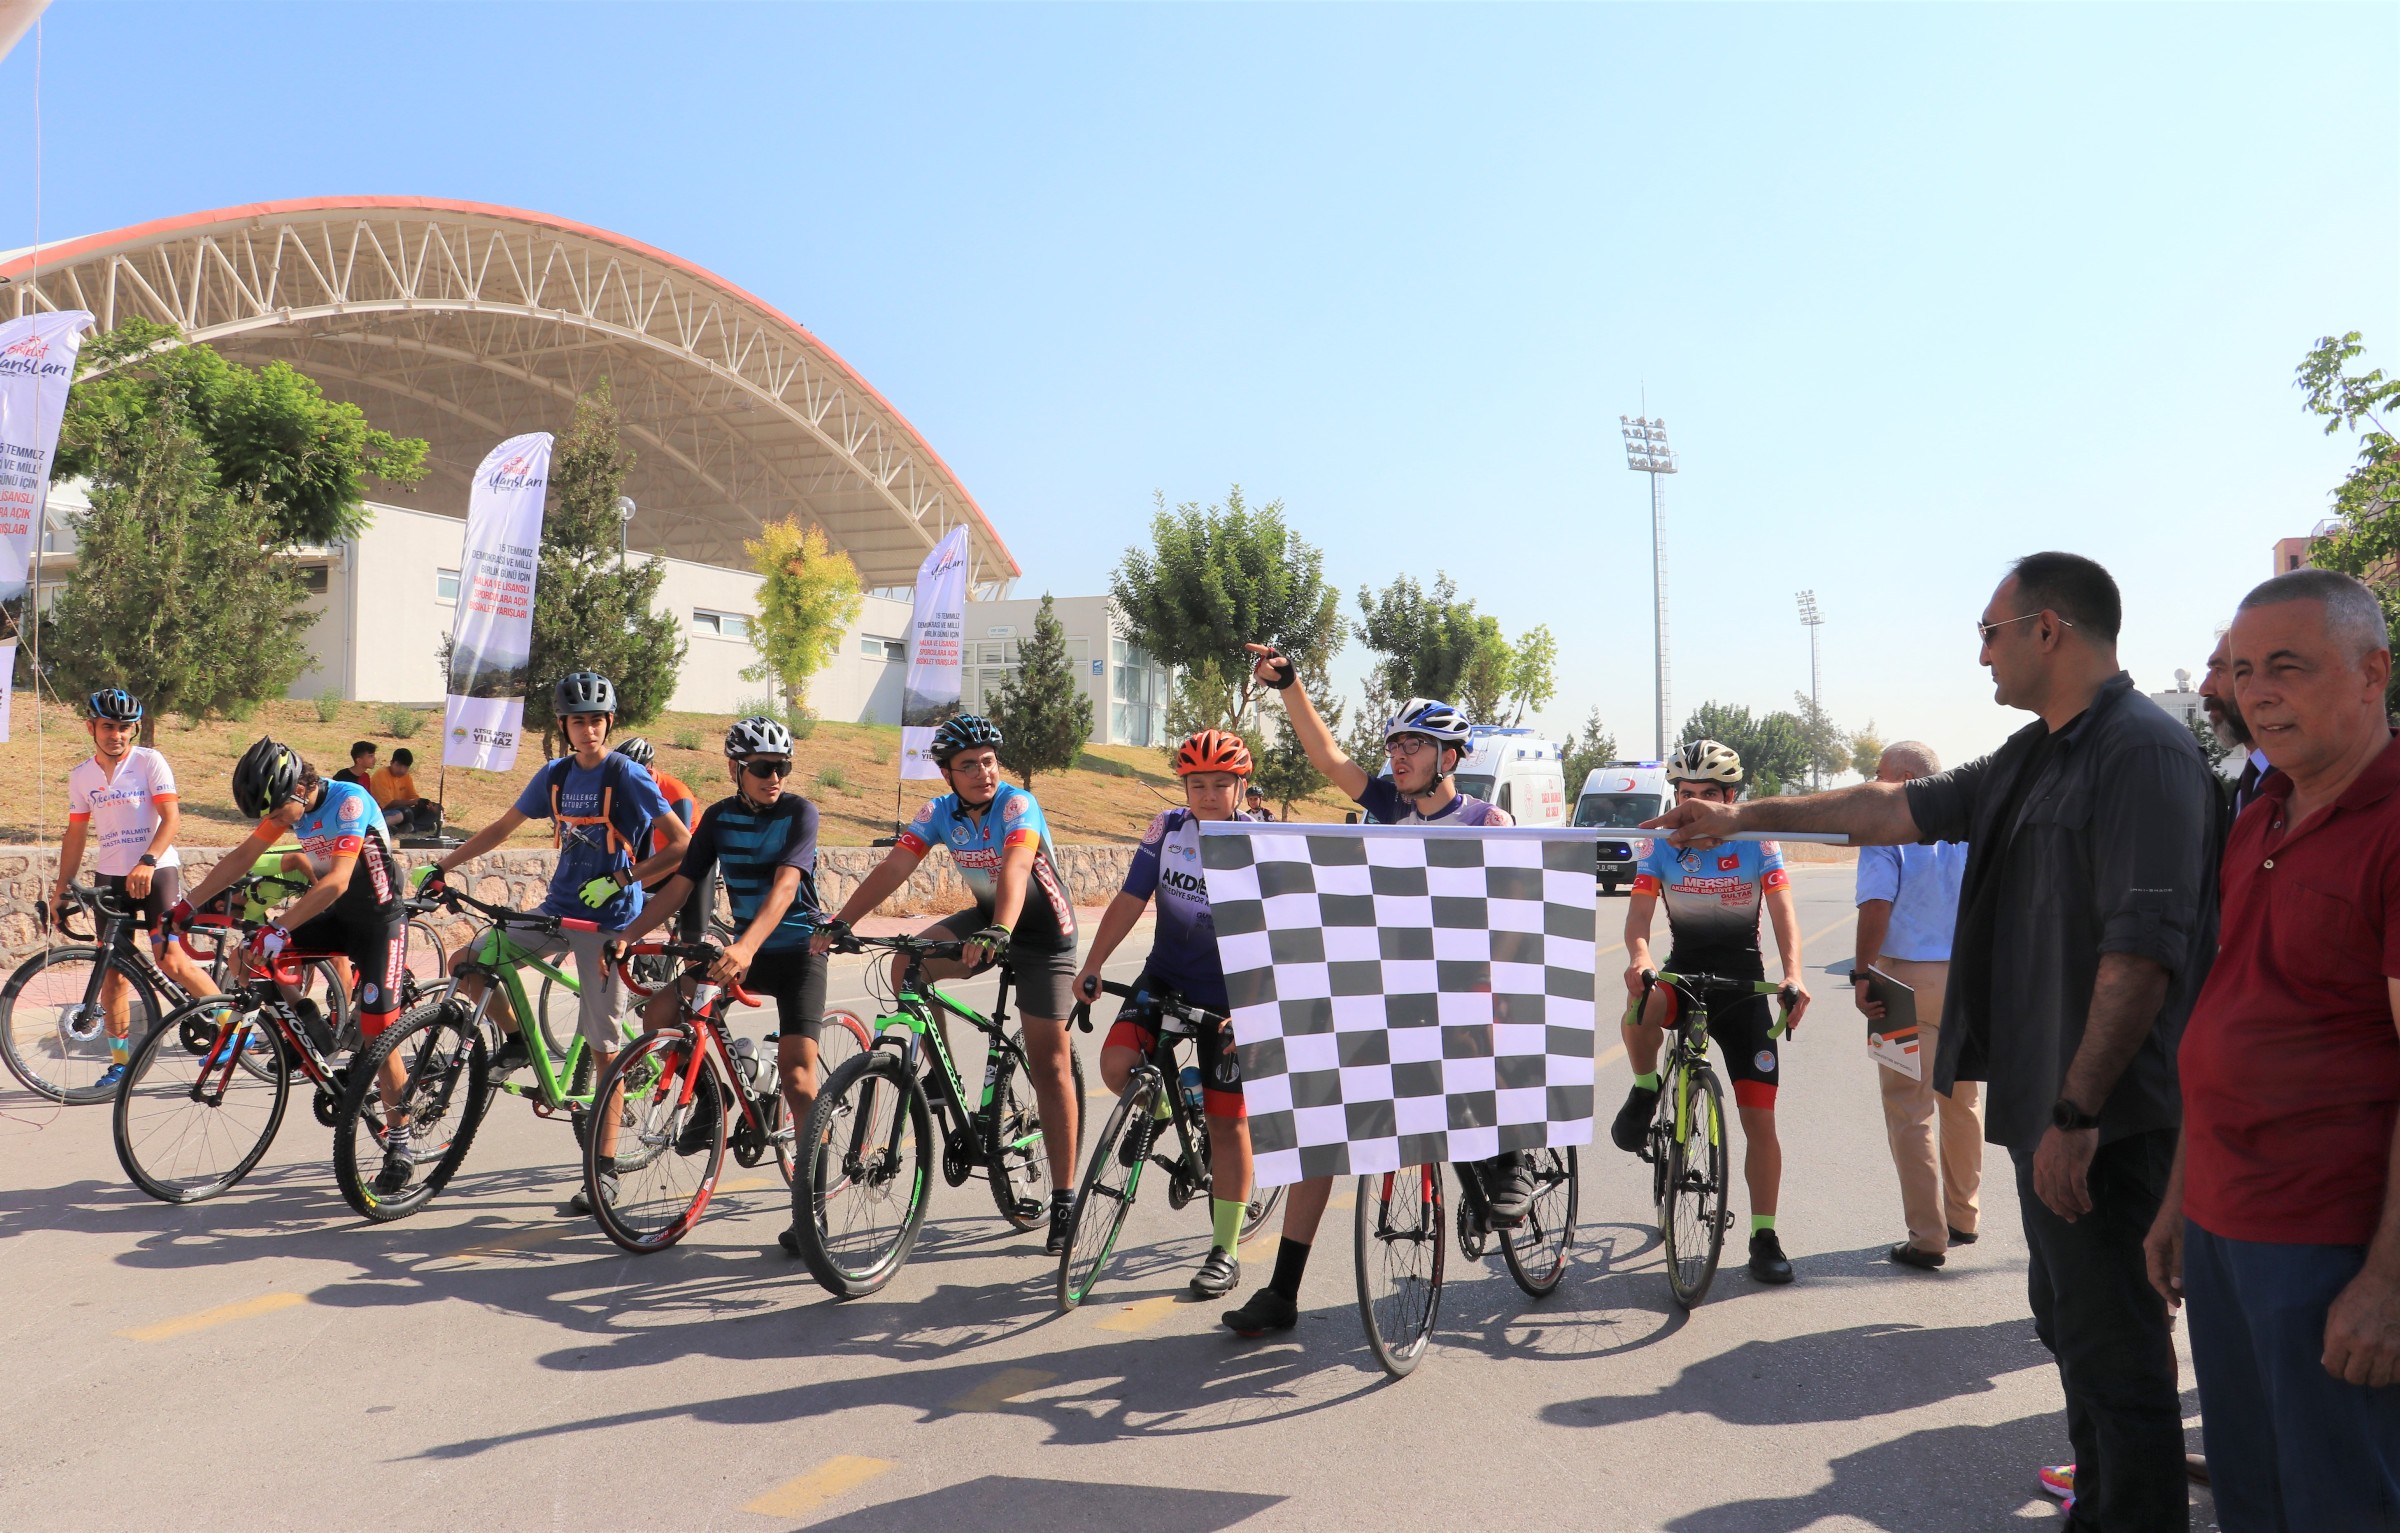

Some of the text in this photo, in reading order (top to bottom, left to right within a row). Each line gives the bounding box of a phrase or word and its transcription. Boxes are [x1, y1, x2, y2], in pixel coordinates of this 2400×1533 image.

[6, 443, 45, 460] TEMMUZ
[4, 459, 15, 470] VE
[472, 549, 506, 566] DEMOKRASİ
[506, 557, 514, 567] VE
[507, 545, 533, 558] TEMMUZ
[473, 575, 493, 588] HALKA
[473, 734, 512, 746] YILMAZ
[561, 793, 598, 801] CHALLENGE
[561, 801, 590, 809] NATURE'S
[274, 1001, 334, 1078] MOSSO
[717, 1027, 756, 1102] MOSSO
[926, 1012, 968, 1110] SALCANO
